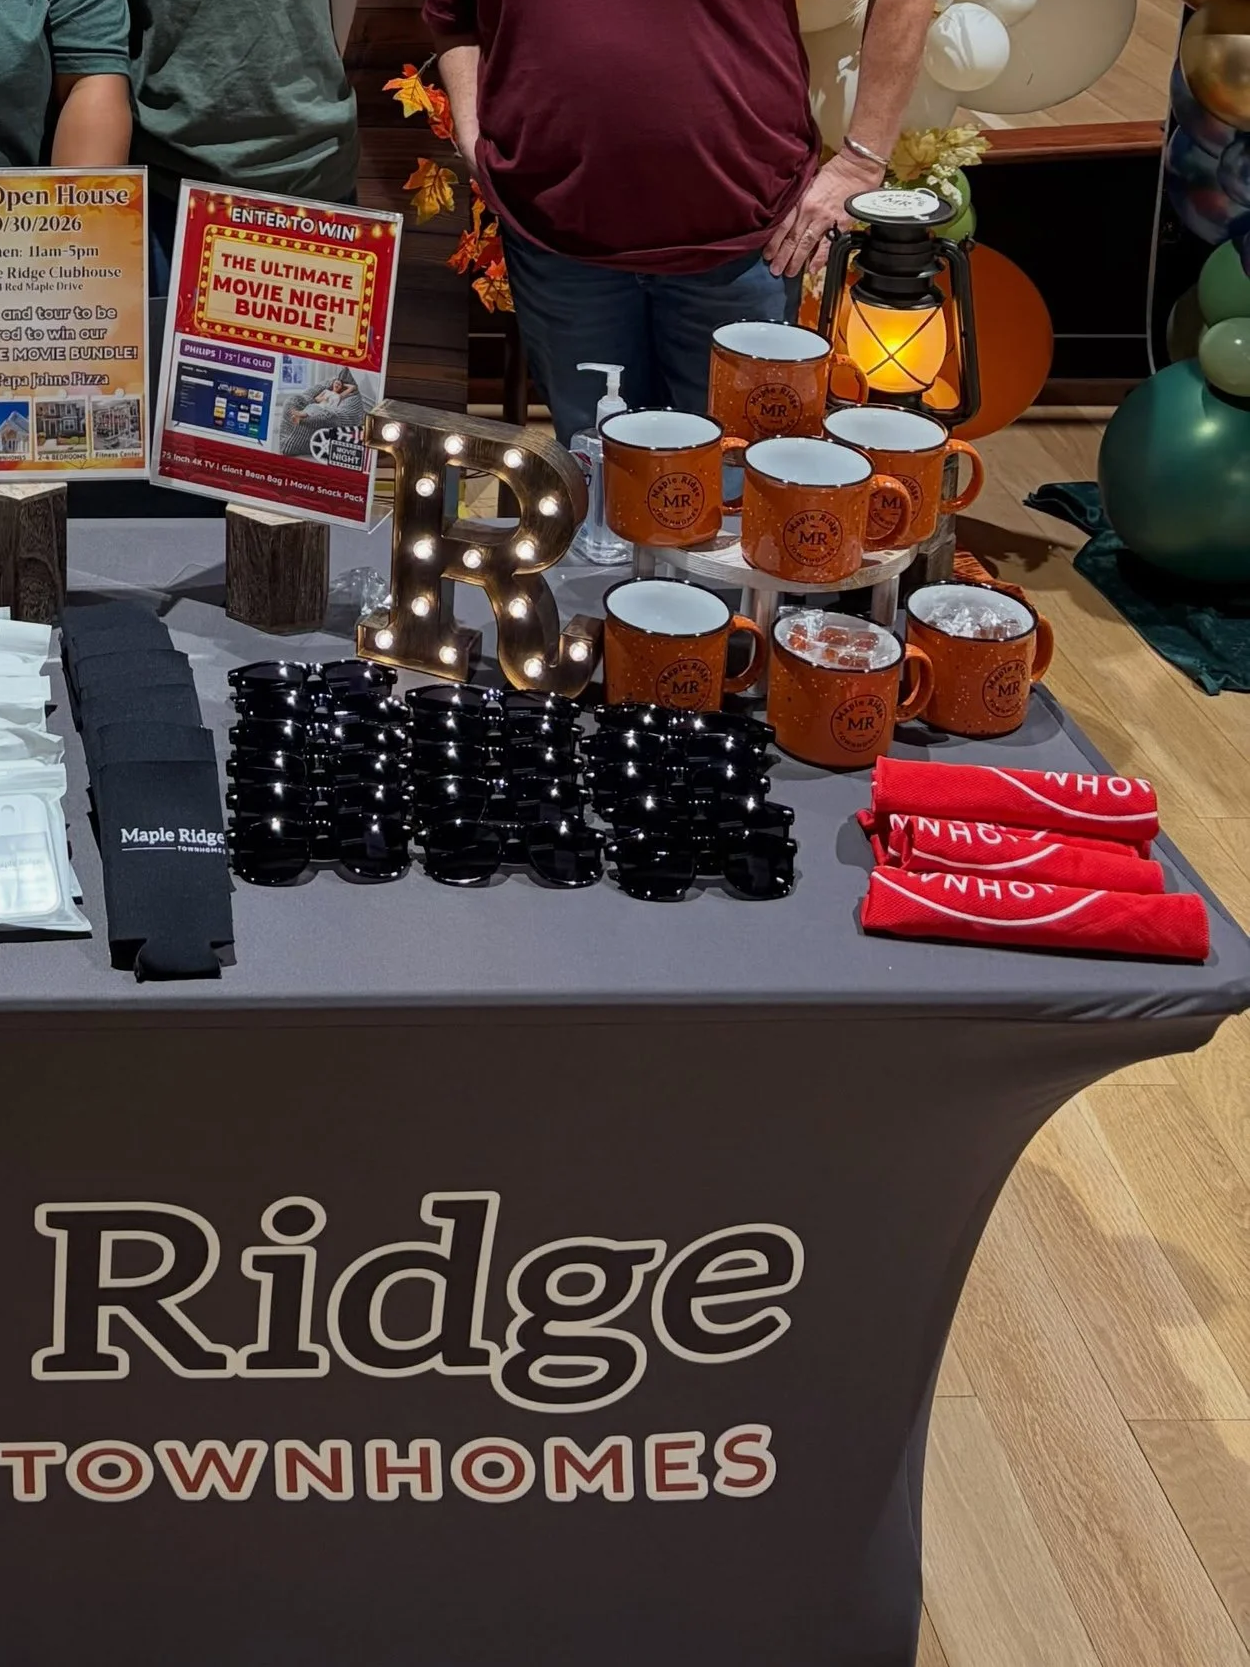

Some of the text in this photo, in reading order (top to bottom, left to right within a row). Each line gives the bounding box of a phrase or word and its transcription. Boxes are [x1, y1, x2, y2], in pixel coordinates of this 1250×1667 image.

[56, 184, 129, 205] House
[231, 208, 357, 242] ENTER TO WIN
[29, 245, 99, 260] 11am-5pm
[7, 267, 46, 282] Ridge
[49, 266, 122, 279] Clubhouse
[221, 253, 353, 290] THE ULTIMATE
[5, 283, 23, 291] Red
[26, 283, 54, 293] Maple
[57, 282, 83, 291] Drive
[213, 274, 360, 317] MOVIE NIGHT
[2, 307, 32, 320] and
[36, 308, 71, 320] tour
[74, 308, 92, 319] to
[96, 306, 117, 319] be
[235, 299, 336, 333] BUNDLE!
[25, 328, 43, 340] to
[46, 326, 76, 340] win
[79, 328, 107, 340] our
[13, 348, 66, 361] MOVIE
[70, 347, 138, 360] BUNDLE!
[184, 344, 216, 358] PHILIPS
[241, 355, 251, 364] 4K
[252, 357, 272, 369] QLED
[31, 372, 69, 389] Johns
[72, 372, 109, 386] Pizza
[760, 404, 787, 417] MR
[332, 453, 360, 465] NIGHT
[336, 446, 357, 456] MOVIE
[173, 453, 190, 464] Inch
[192, 458, 202, 467] 4K
[204, 460, 215, 470] TV
[222, 464, 243, 476] Giant
[245, 470, 265, 481] Bean
[267, 474, 282, 486] Bag
[290, 479, 315, 492] Movie
[317, 486, 342, 498] Snack
[344, 492, 364, 503] Pack
[651, 475, 700, 499] Maple Ridge
[663, 494, 691, 508] MR
[788, 514, 838, 536] Maple Ridge
[798, 531, 828, 545] MR
[357, 398, 605, 699] R
[660, 664, 688, 684] Maple
[671, 681, 699, 694] MR
[998, 681, 1020, 697] MR
[835, 700, 864, 721] Maple
[847, 717, 874, 731] MR
[120, 827, 225, 846] Maple Ridge
[32, 1190, 804, 1412] Ridge
